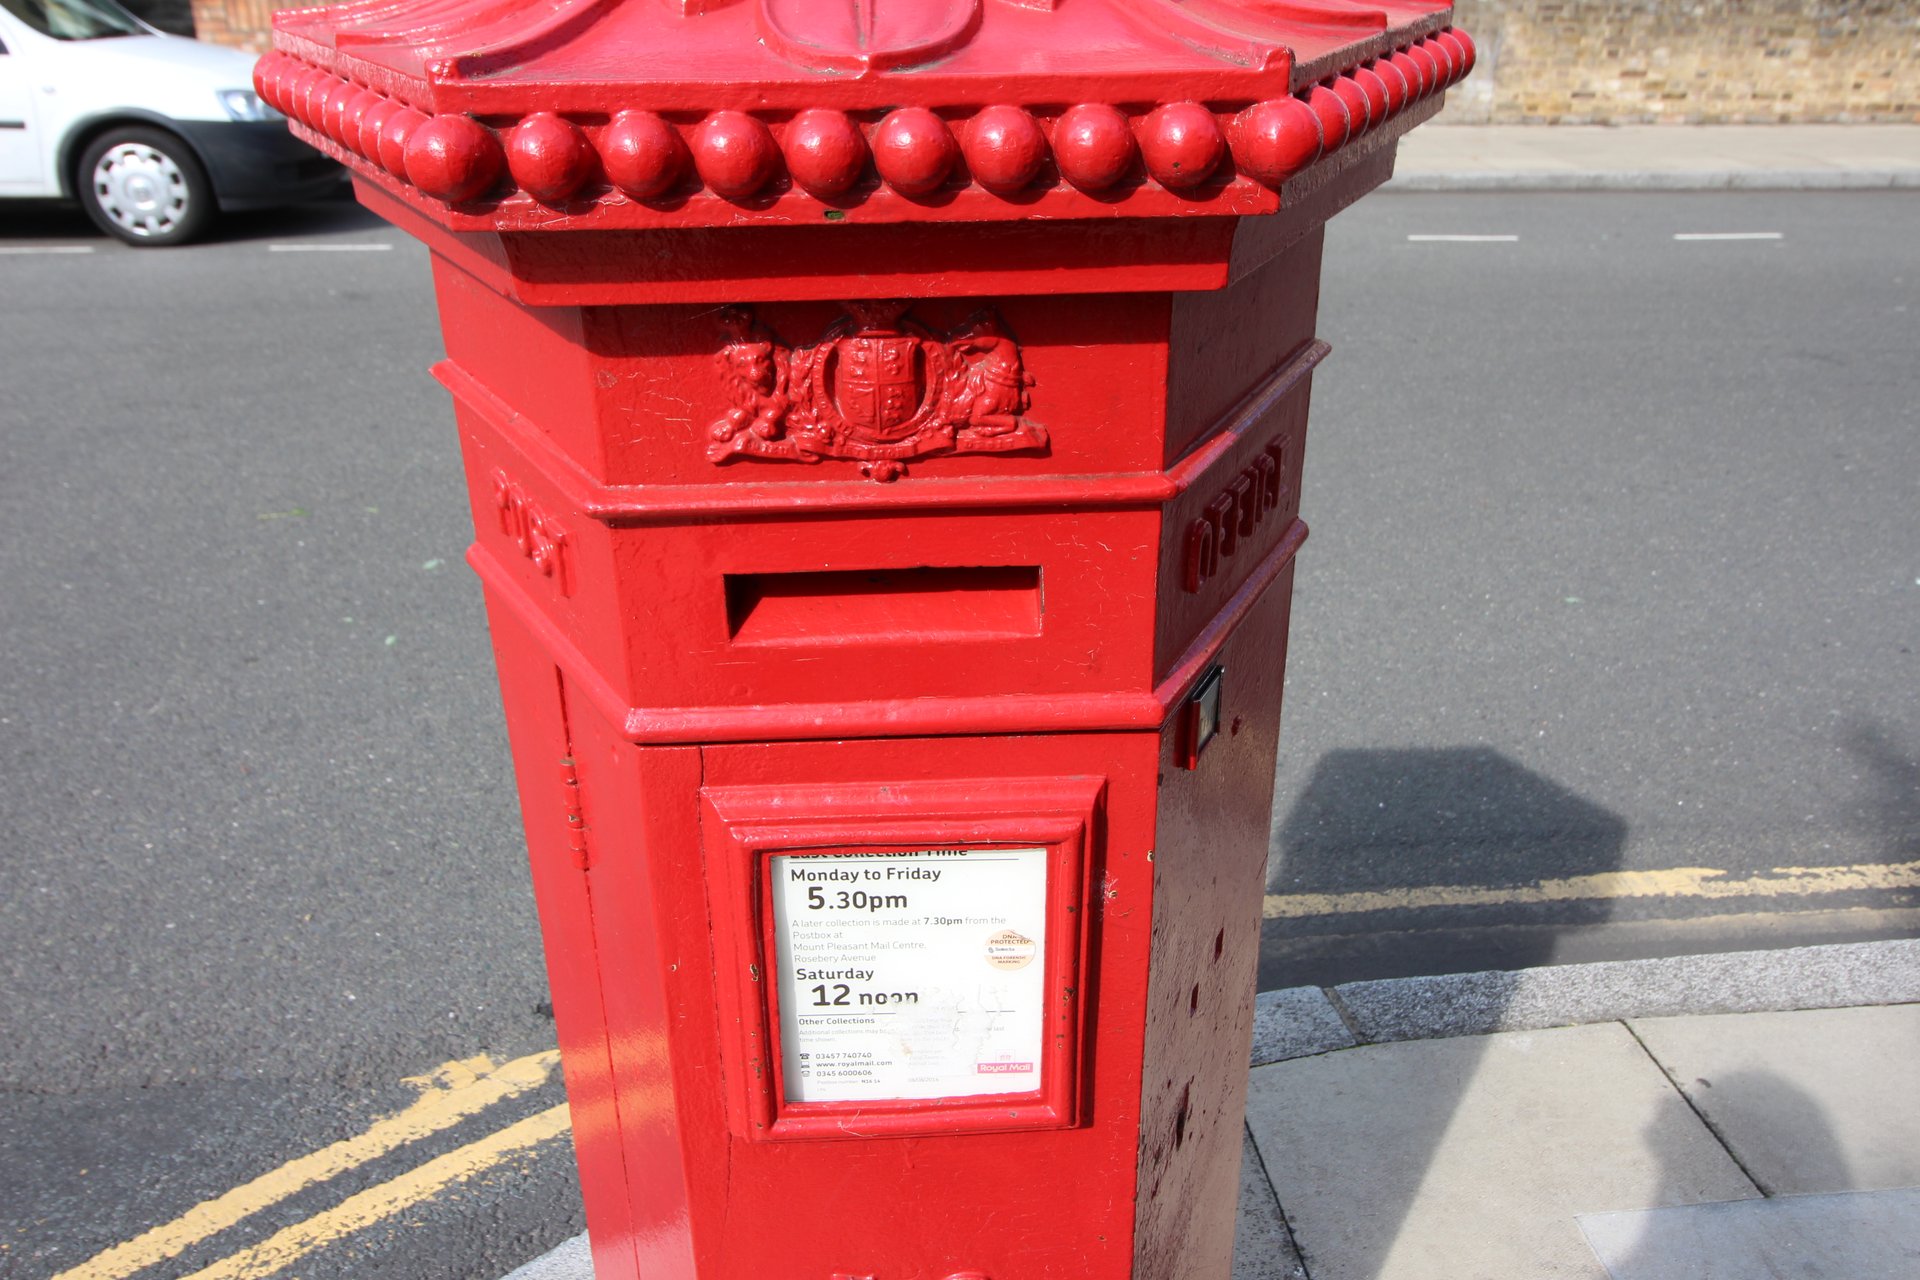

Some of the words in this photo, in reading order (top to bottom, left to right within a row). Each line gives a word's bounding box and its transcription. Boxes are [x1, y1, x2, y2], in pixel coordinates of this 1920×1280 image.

[790, 868, 860, 884] Monday
[864, 869, 881, 881] to
[886, 867, 942, 883] Friday
[808, 886, 908, 913] 5.30pm
[801, 919, 823, 928] later
[825, 918, 871, 927] collection
[872, 918, 880, 926] is
[882, 917, 910, 926] made
[912, 917, 921, 926] at
[923, 917, 963, 926] 7.30pm
[965, 917, 988, 925] from
[991, 916, 1006, 925] the
[793, 931, 831, 940] Postbox
[833, 931, 843, 939] at
[793, 942, 825, 951] Mount
[827, 942, 868, 951] Pleasant
[870, 941, 890, 950] Mail
[794, 954, 839, 963] Rosebery
[840, 953, 877, 962] Avenue
[796, 967, 874, 982] Saturday
[811, 983, 851, 1006] 12
[858, 991, 919, 1006] noon
[798, 1017, 825, 1025] Other
[826, 1017, 875, 1025] Collections
[815, 1052, 840, 1060] 03457
[842, 1051, 872, 1059] 740740
[816, 1060, 893, 1068] www.royalmail.com
[980, 1064, 1007, 1072] Royal
[1010, 1063, 1031, 1071] Mail
[838, 1069, 873, 1077] 6000606
